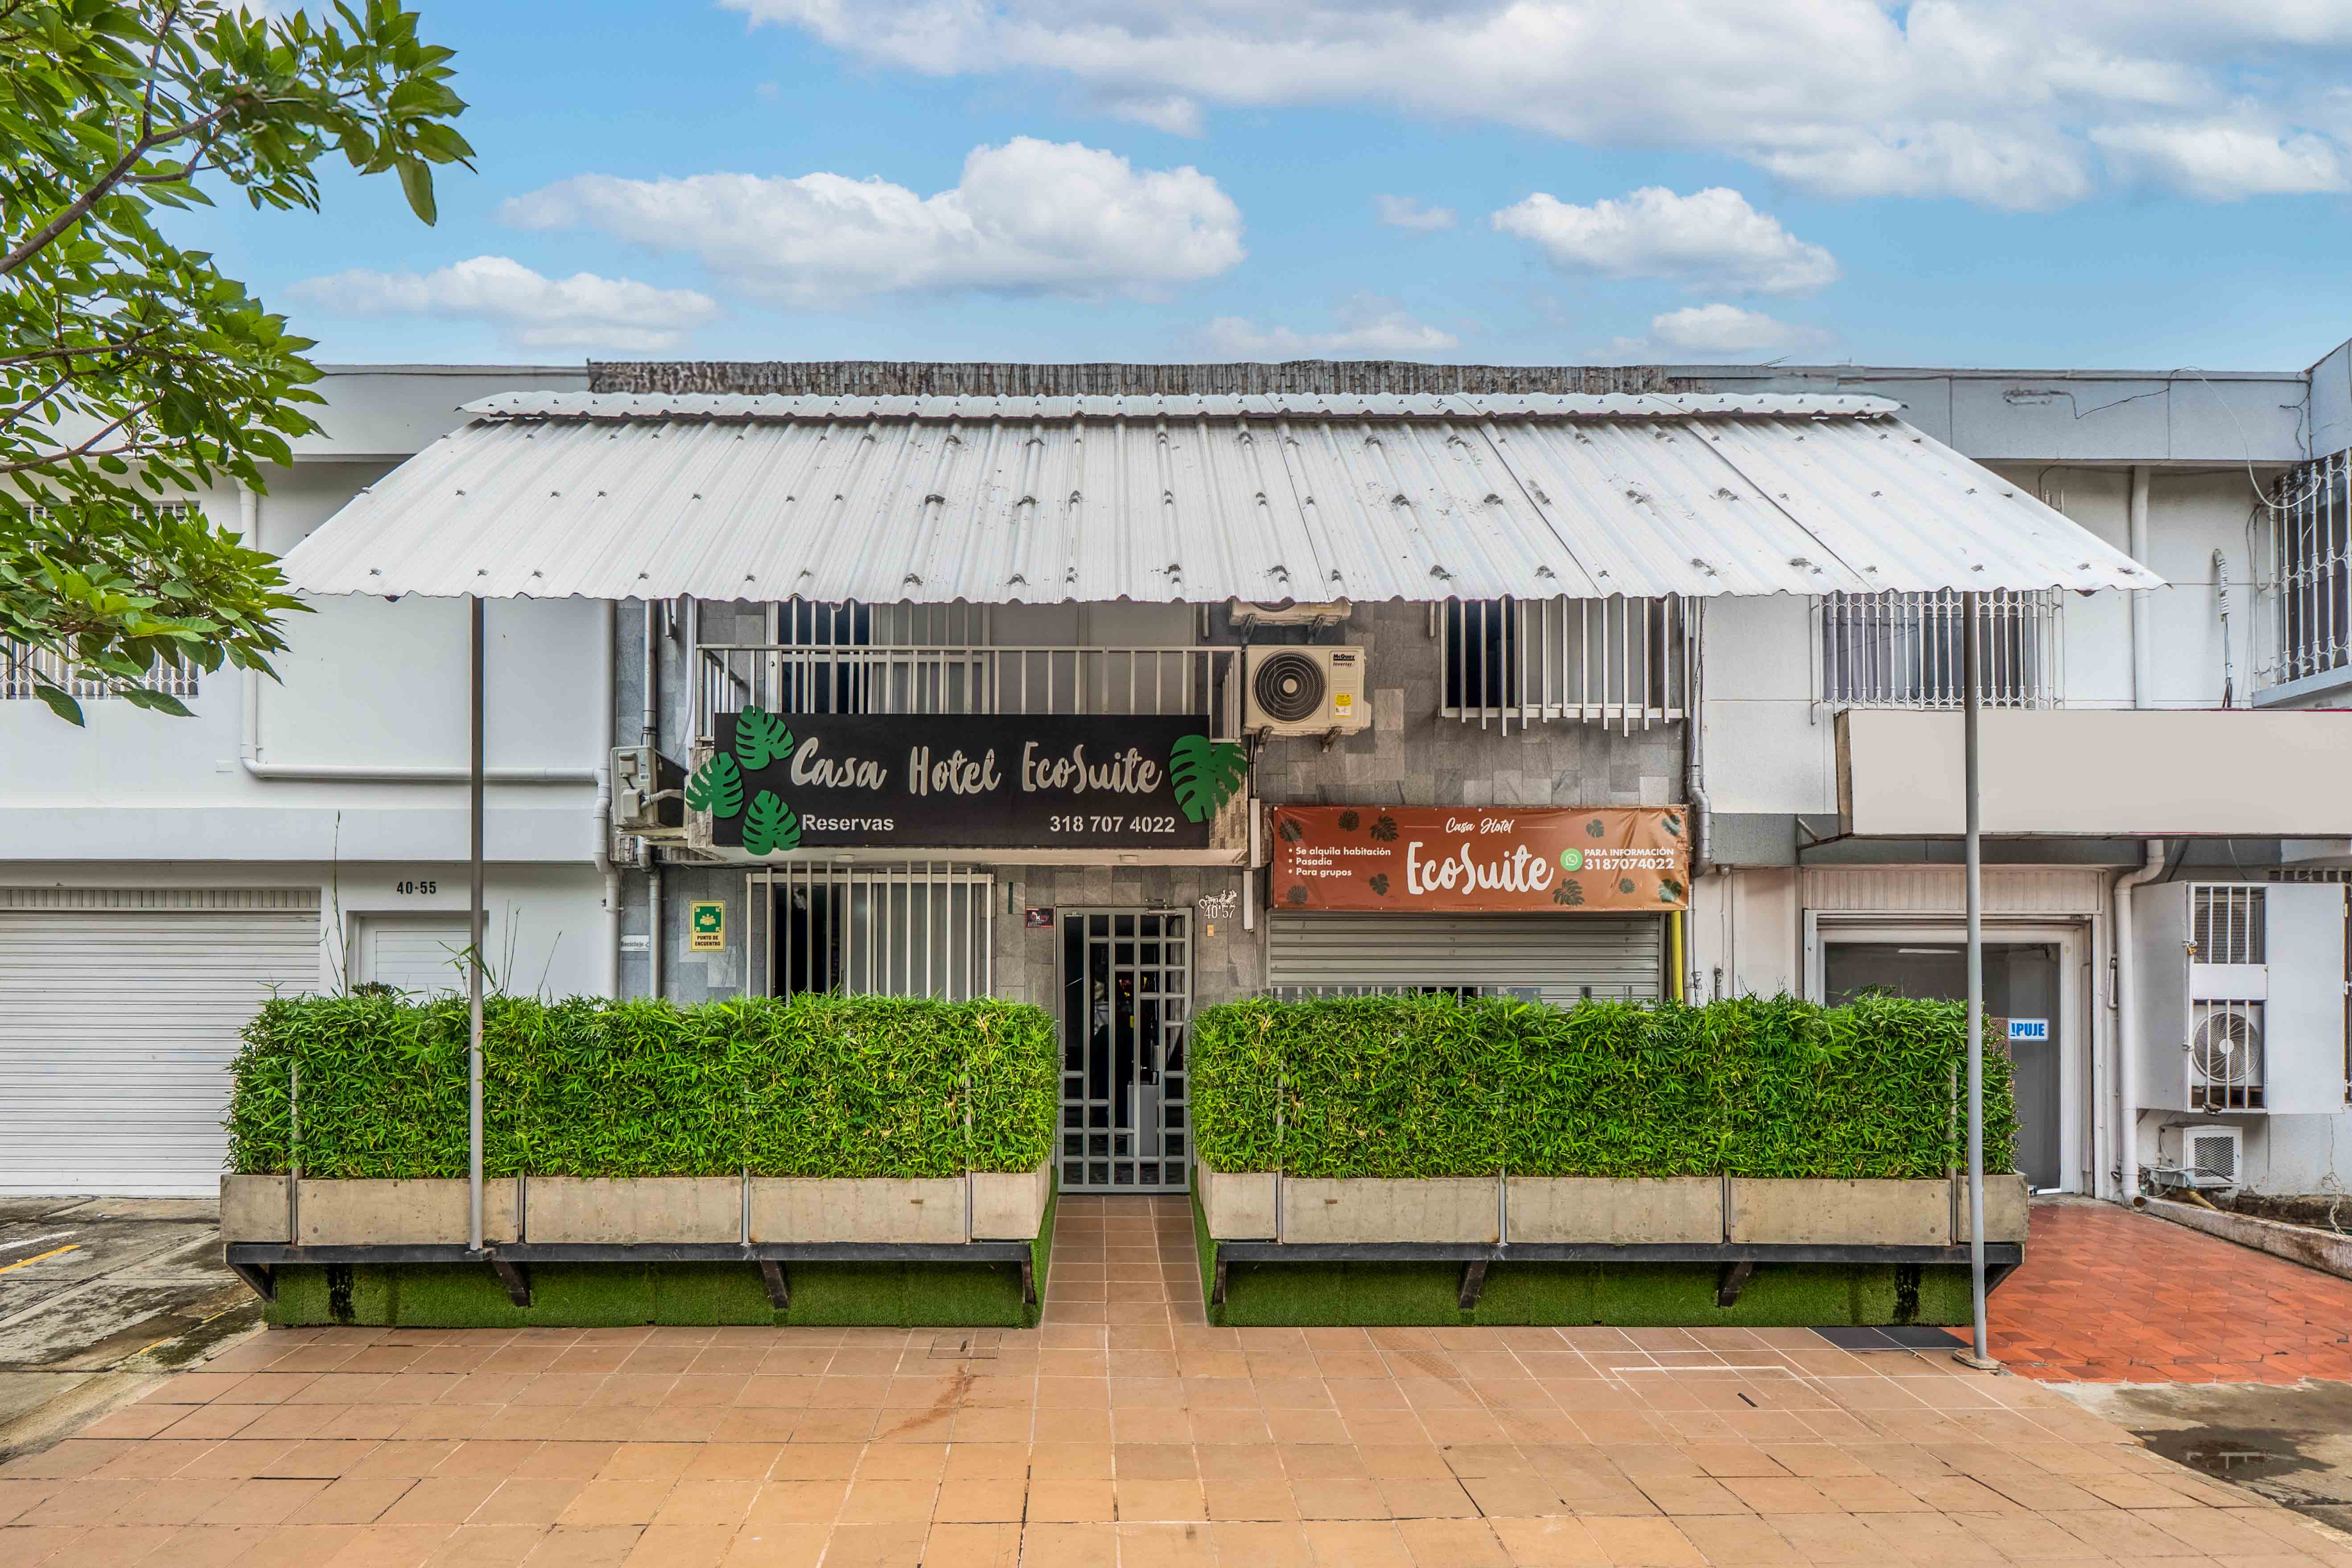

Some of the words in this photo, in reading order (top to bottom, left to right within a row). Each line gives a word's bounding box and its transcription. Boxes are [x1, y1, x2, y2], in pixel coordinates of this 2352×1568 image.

[791, 737, 887, 790] Casa
[909, 746, 1001, 796] Hotel
[1022, 741, 1162, 794] EcoSuite
[803, 814, 894, 831] Reservas
[1050, 815, 1084, 832] 318
[1090, 816, 1124, 832] 707
[1129, 816, 1175, 833] 4022
[1446, 817, 1475, 833] Casa
[1480, 818, 1515, 834] Hotel
[1296, 847, 1306, 855] Se
[1310, 847, 1341, 857] alquila
[1343, 847, 1391, 856] habitación
[1610, 847, 1674, 856] INFORMACIÓN
[1296, 857, 1332, 865] Pasadía
[1585, 858, 1675, 870] 3187074022
[1296, 868, 1317, 876] Para
[1320, 869, 1352, 878] grupos
[1407, 842, 1554, 895] EcoSuite
